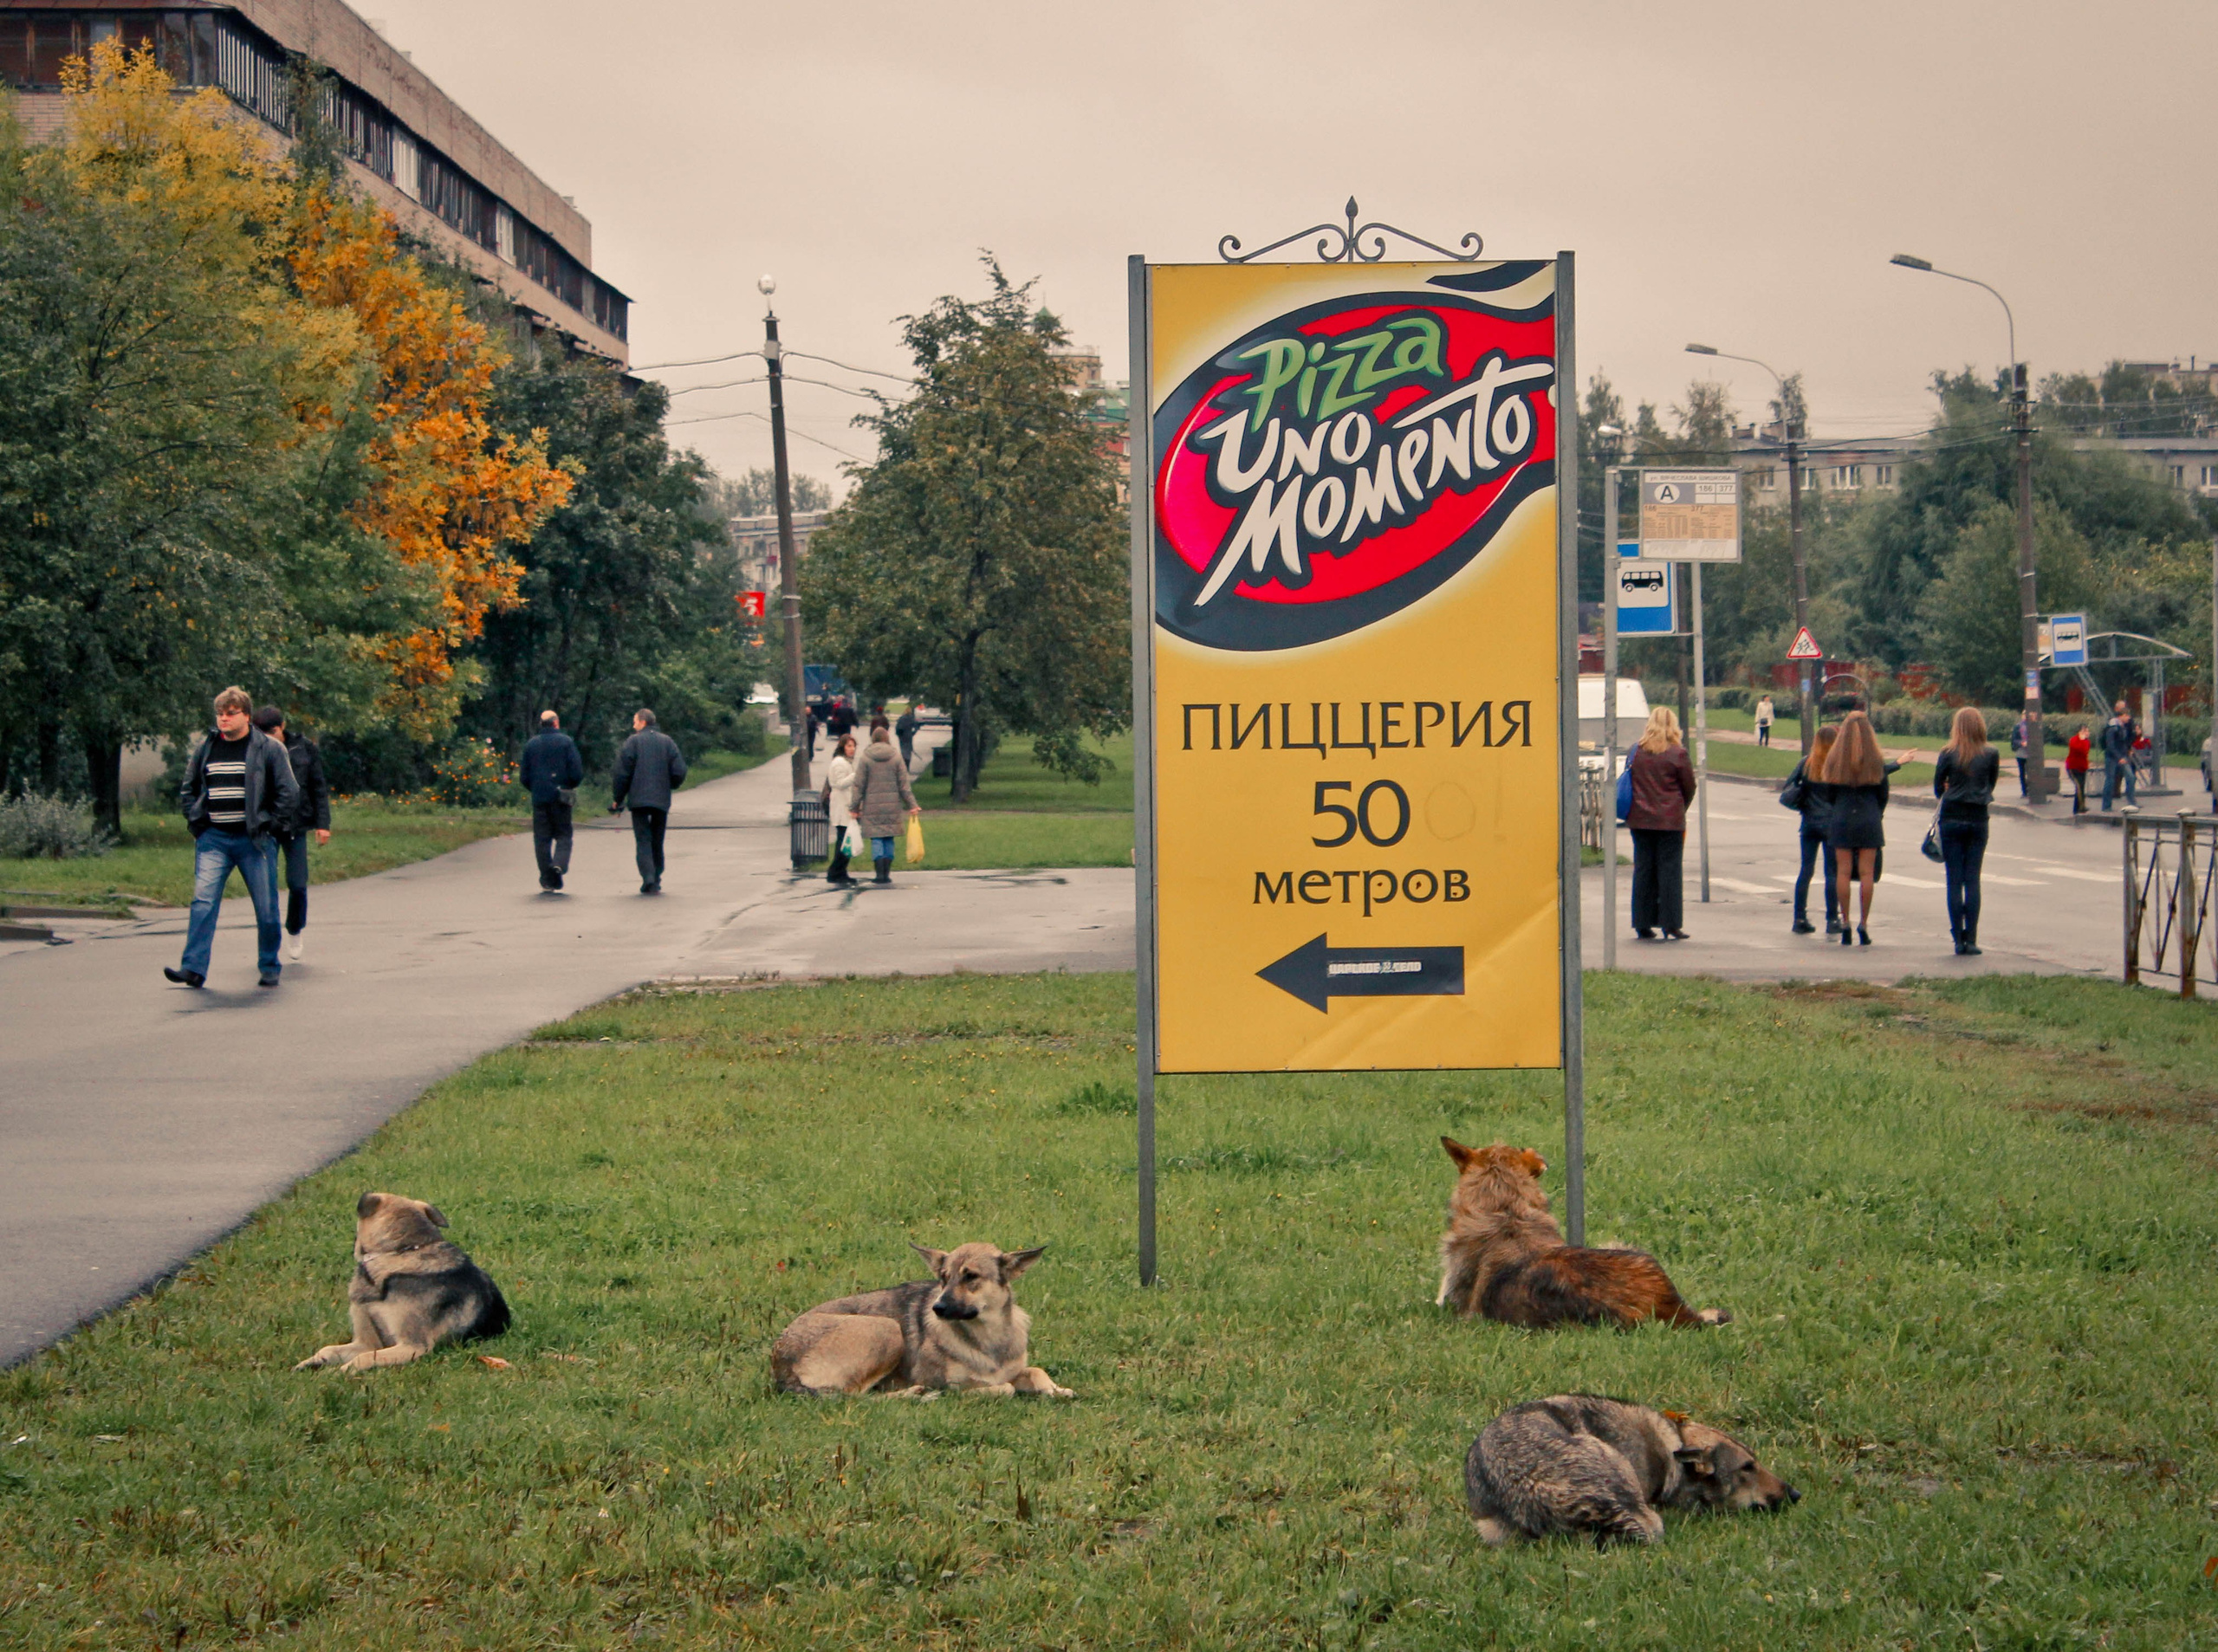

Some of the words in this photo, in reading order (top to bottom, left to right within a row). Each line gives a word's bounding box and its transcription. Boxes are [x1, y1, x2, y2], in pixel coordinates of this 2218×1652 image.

[1236, 317, 1444, 432] Pizza
[1199, 409, 1372, 494] UNO
[1181, 700, 1533, 761] ПИЦЦЕРИЯ
[1311, 779, 1411, 848] 50
[1252, 868, 1471, 918] метров
